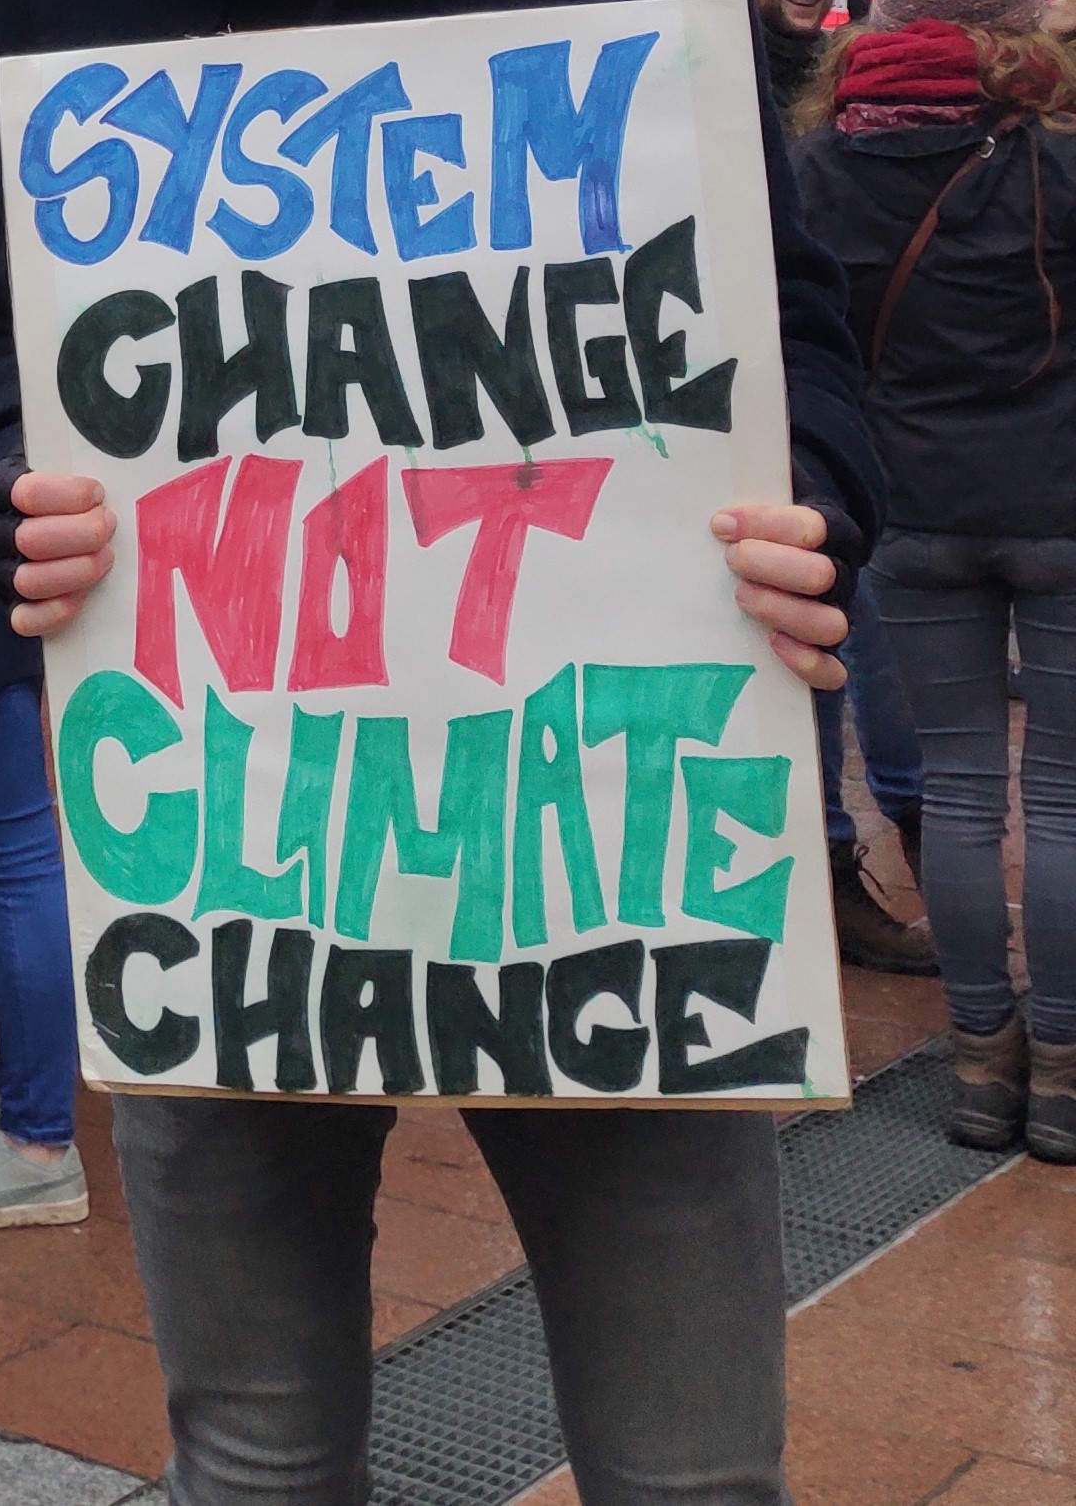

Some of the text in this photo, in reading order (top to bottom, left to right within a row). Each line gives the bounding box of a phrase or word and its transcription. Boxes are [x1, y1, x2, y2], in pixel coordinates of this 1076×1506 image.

[18, 32, 661, 266] SYSTEM
[56, 215, 738, 462] CHANGE
[134, 454, 615, 710] NOT
[56, 662, 794, 962] CLIMATE
[85, 912, 810, 1097] CHANGE
